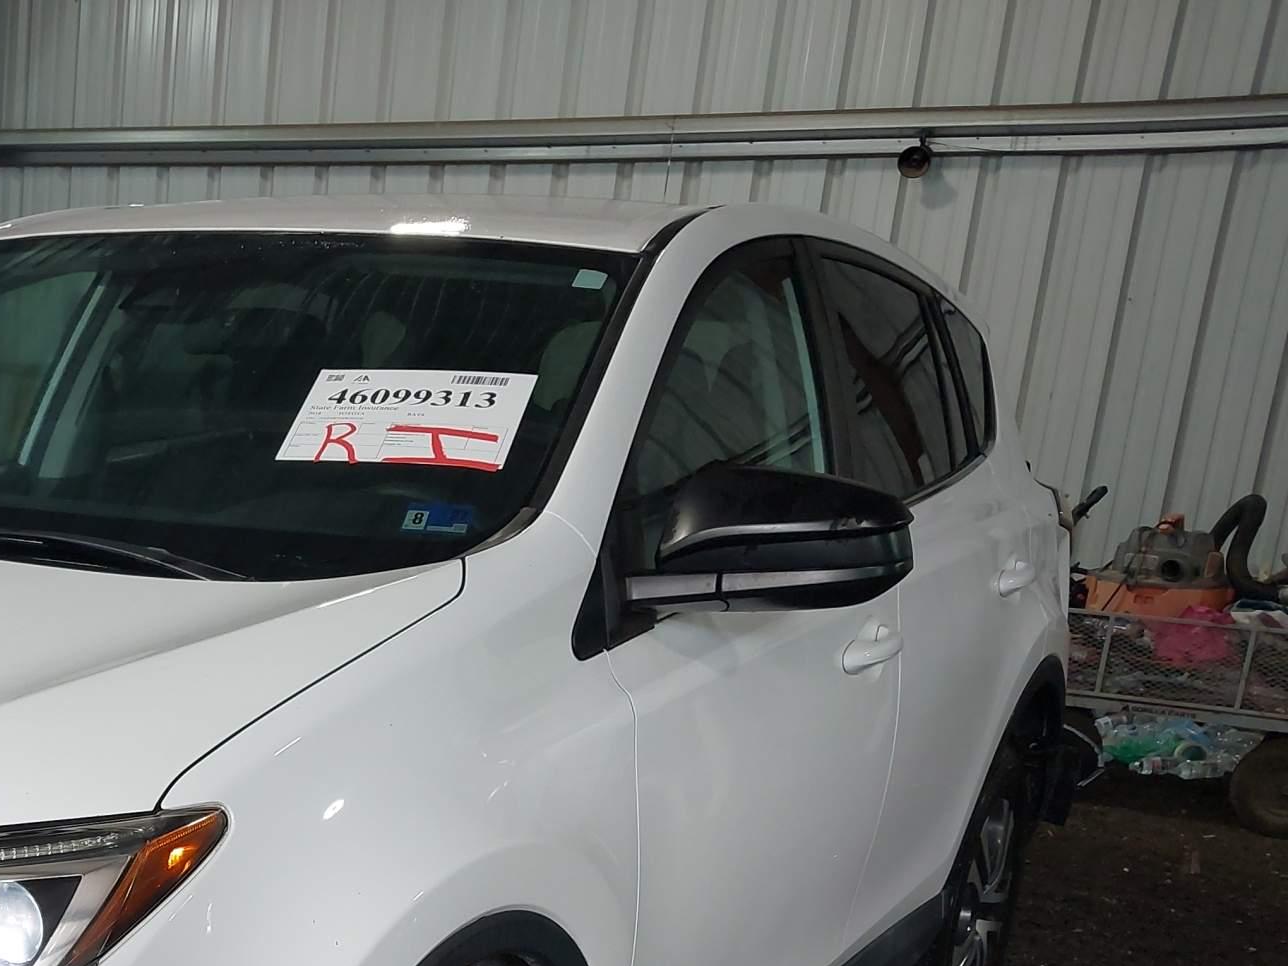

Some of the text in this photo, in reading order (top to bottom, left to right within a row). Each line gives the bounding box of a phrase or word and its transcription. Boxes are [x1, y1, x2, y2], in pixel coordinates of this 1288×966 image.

[328, 388, 497, 408] 46099313
[313, 422, 501, 472] R I
[412, 512, 424, 524] 8
